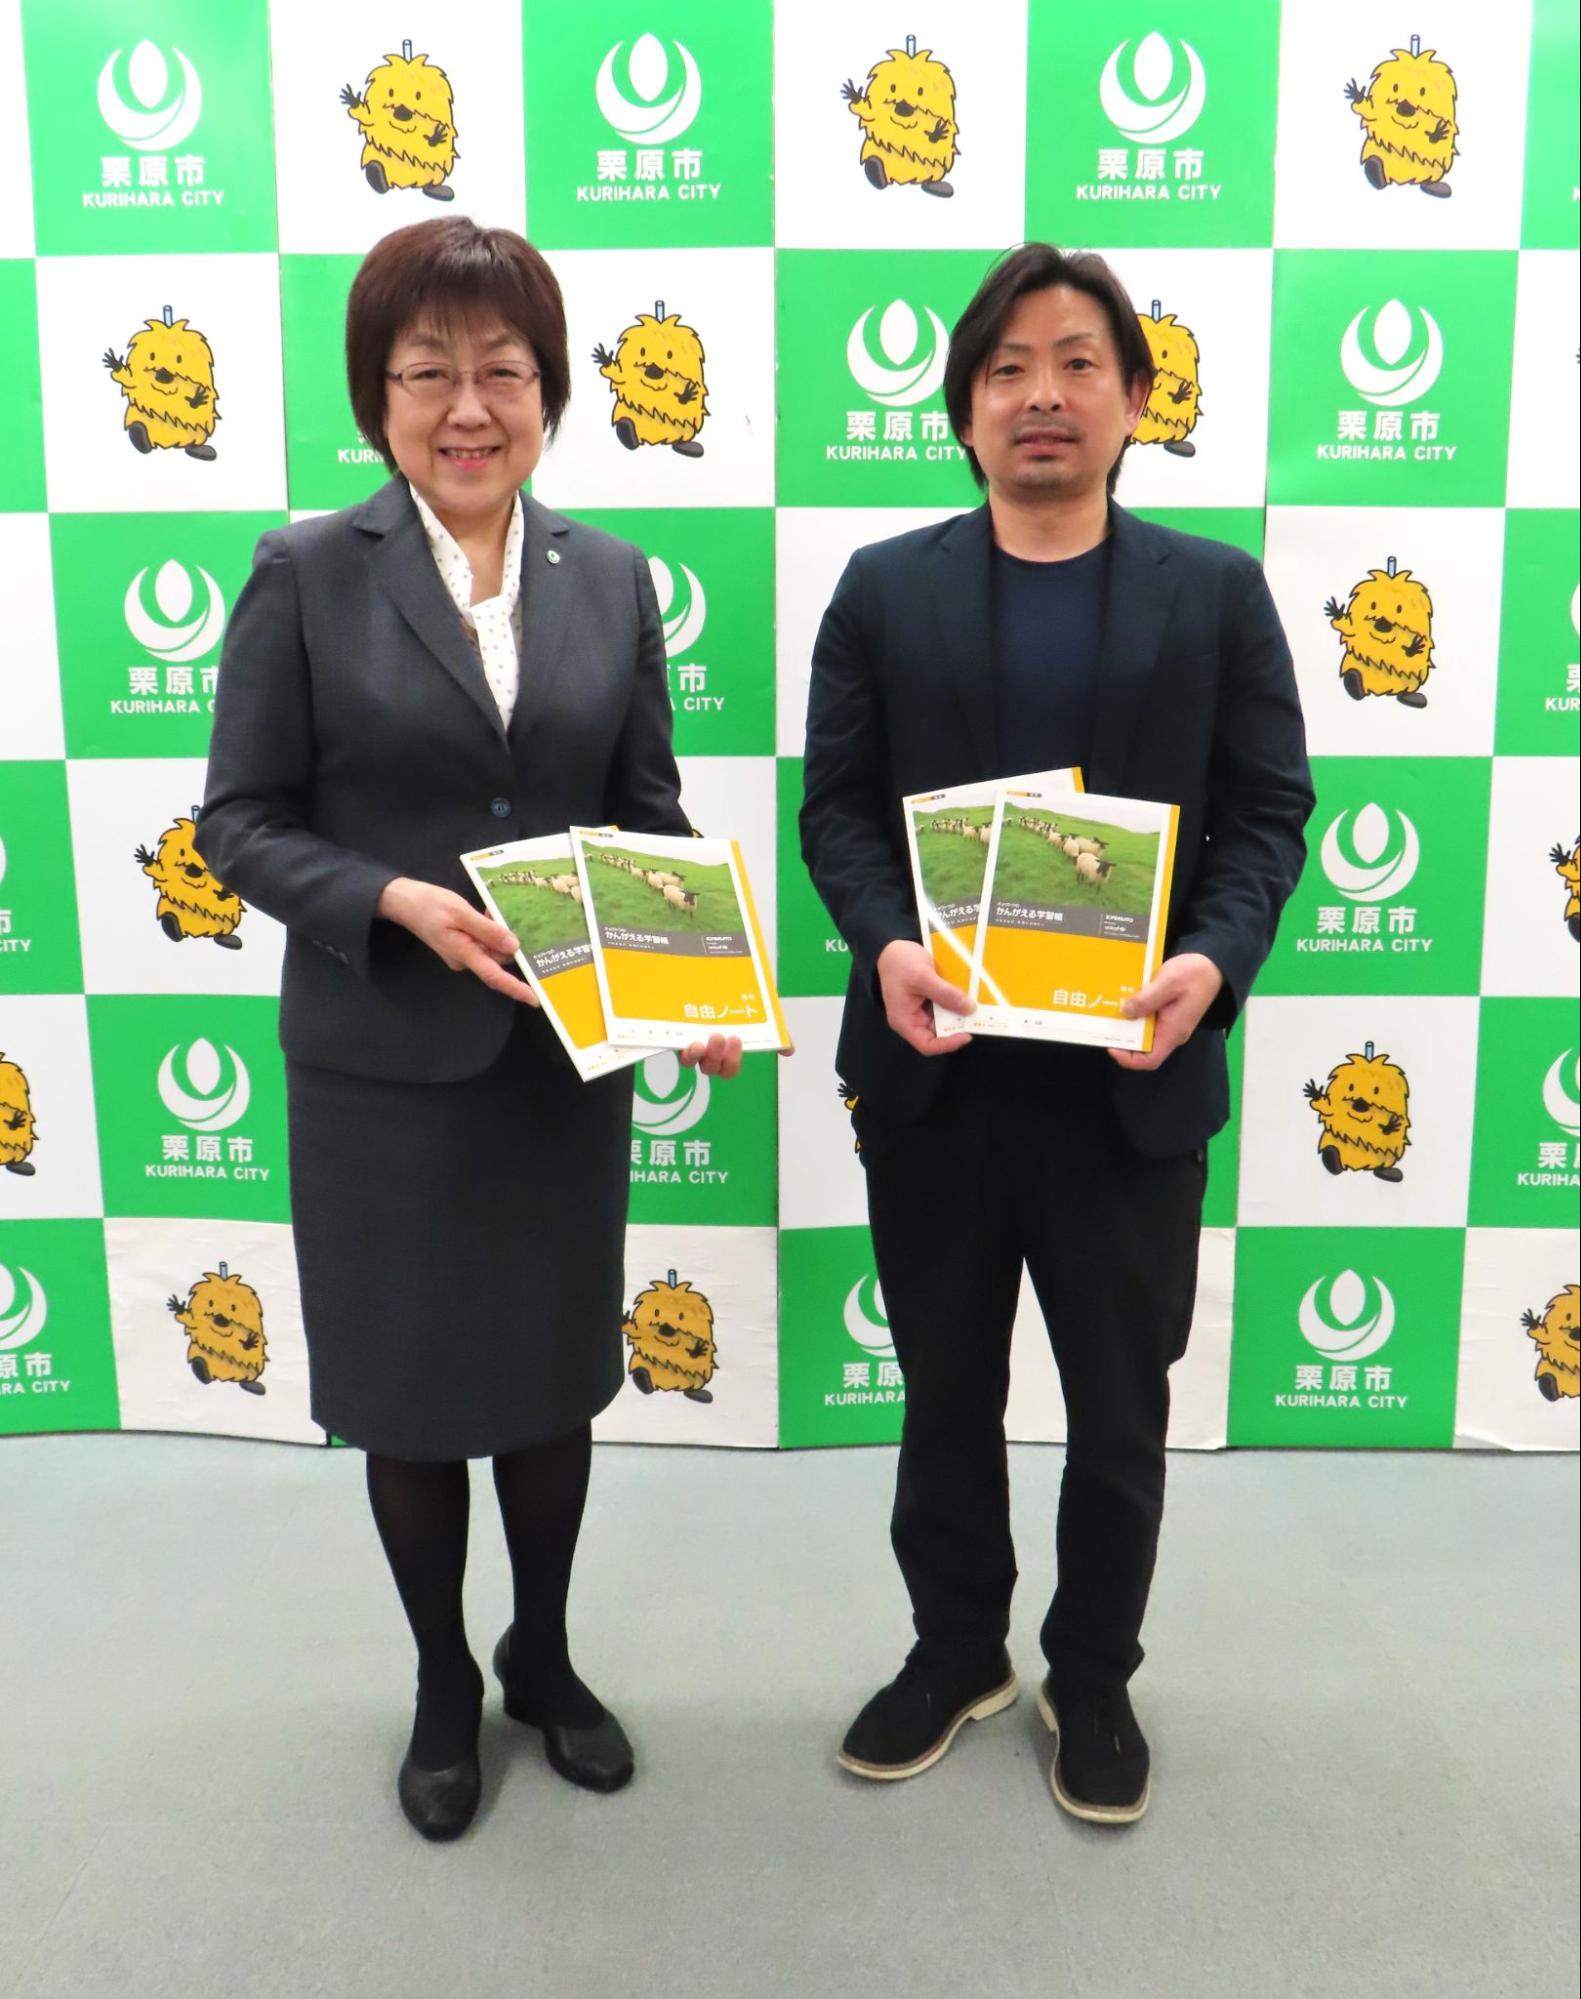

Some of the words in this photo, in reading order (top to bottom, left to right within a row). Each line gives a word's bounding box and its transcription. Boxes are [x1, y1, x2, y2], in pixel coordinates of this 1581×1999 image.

[101, 154, 204, 187] 栗原市
[597, 147, 702, 181] 栗原市
[1097, 148, 1204, 180] 栗原市
[83, 192, 174, 207] KURIHARA
[182, 190, 224, 206] CITY
[577, 186, 669, 201] KURIHARA
[678, 184, 720, 200] CITY
[1077, 185, 1169, 199] KURIHARA
[1178, 184, 1221, 199] CITY
[847, 410, 948, 441] 栗原市
[1338, 410, 1440, 441] 栗原市
[827, 446, 917, 459] KURIHARA
[926, 446, 966, 460] CITY
[1317, 445, 1405, 459] KURIHARA
[1414, 446, 1456, 460] CITY
[667, 664, 706, 692] 市
[112, 700, 199, 713] KURIHARA
[684, 697, 724, 711] CITY
[1318, 907, 1416, 934] 栗原市
[0, 939, 30, 951] ITY
[1297, 939, 1383, 951] KURIHARA
[1392, 939, 1432, 951] CITY
[536, 944, 592, 968] かんがえる学習
[684, 1003, 759, 1019] 自由ノート
[162, 1135, 253, 1163] 栗原市
[1539, 1142, 1579, 1168] 栗
[146, 1165, 226, 1178] KURIHARA
[234, 1167, 269, 1180] CITY
[689, 1171, 728, 1183] CITY
[843, 1362, 904, 1388] 栗原
[1296, 1365, 1391, 1391] 栗原市
[32, 1381, 69, 1392] CITY
[1276, 1395, 1359, 1406] KURIHARA
[1368, 1396, 1406, 1407] CITY
